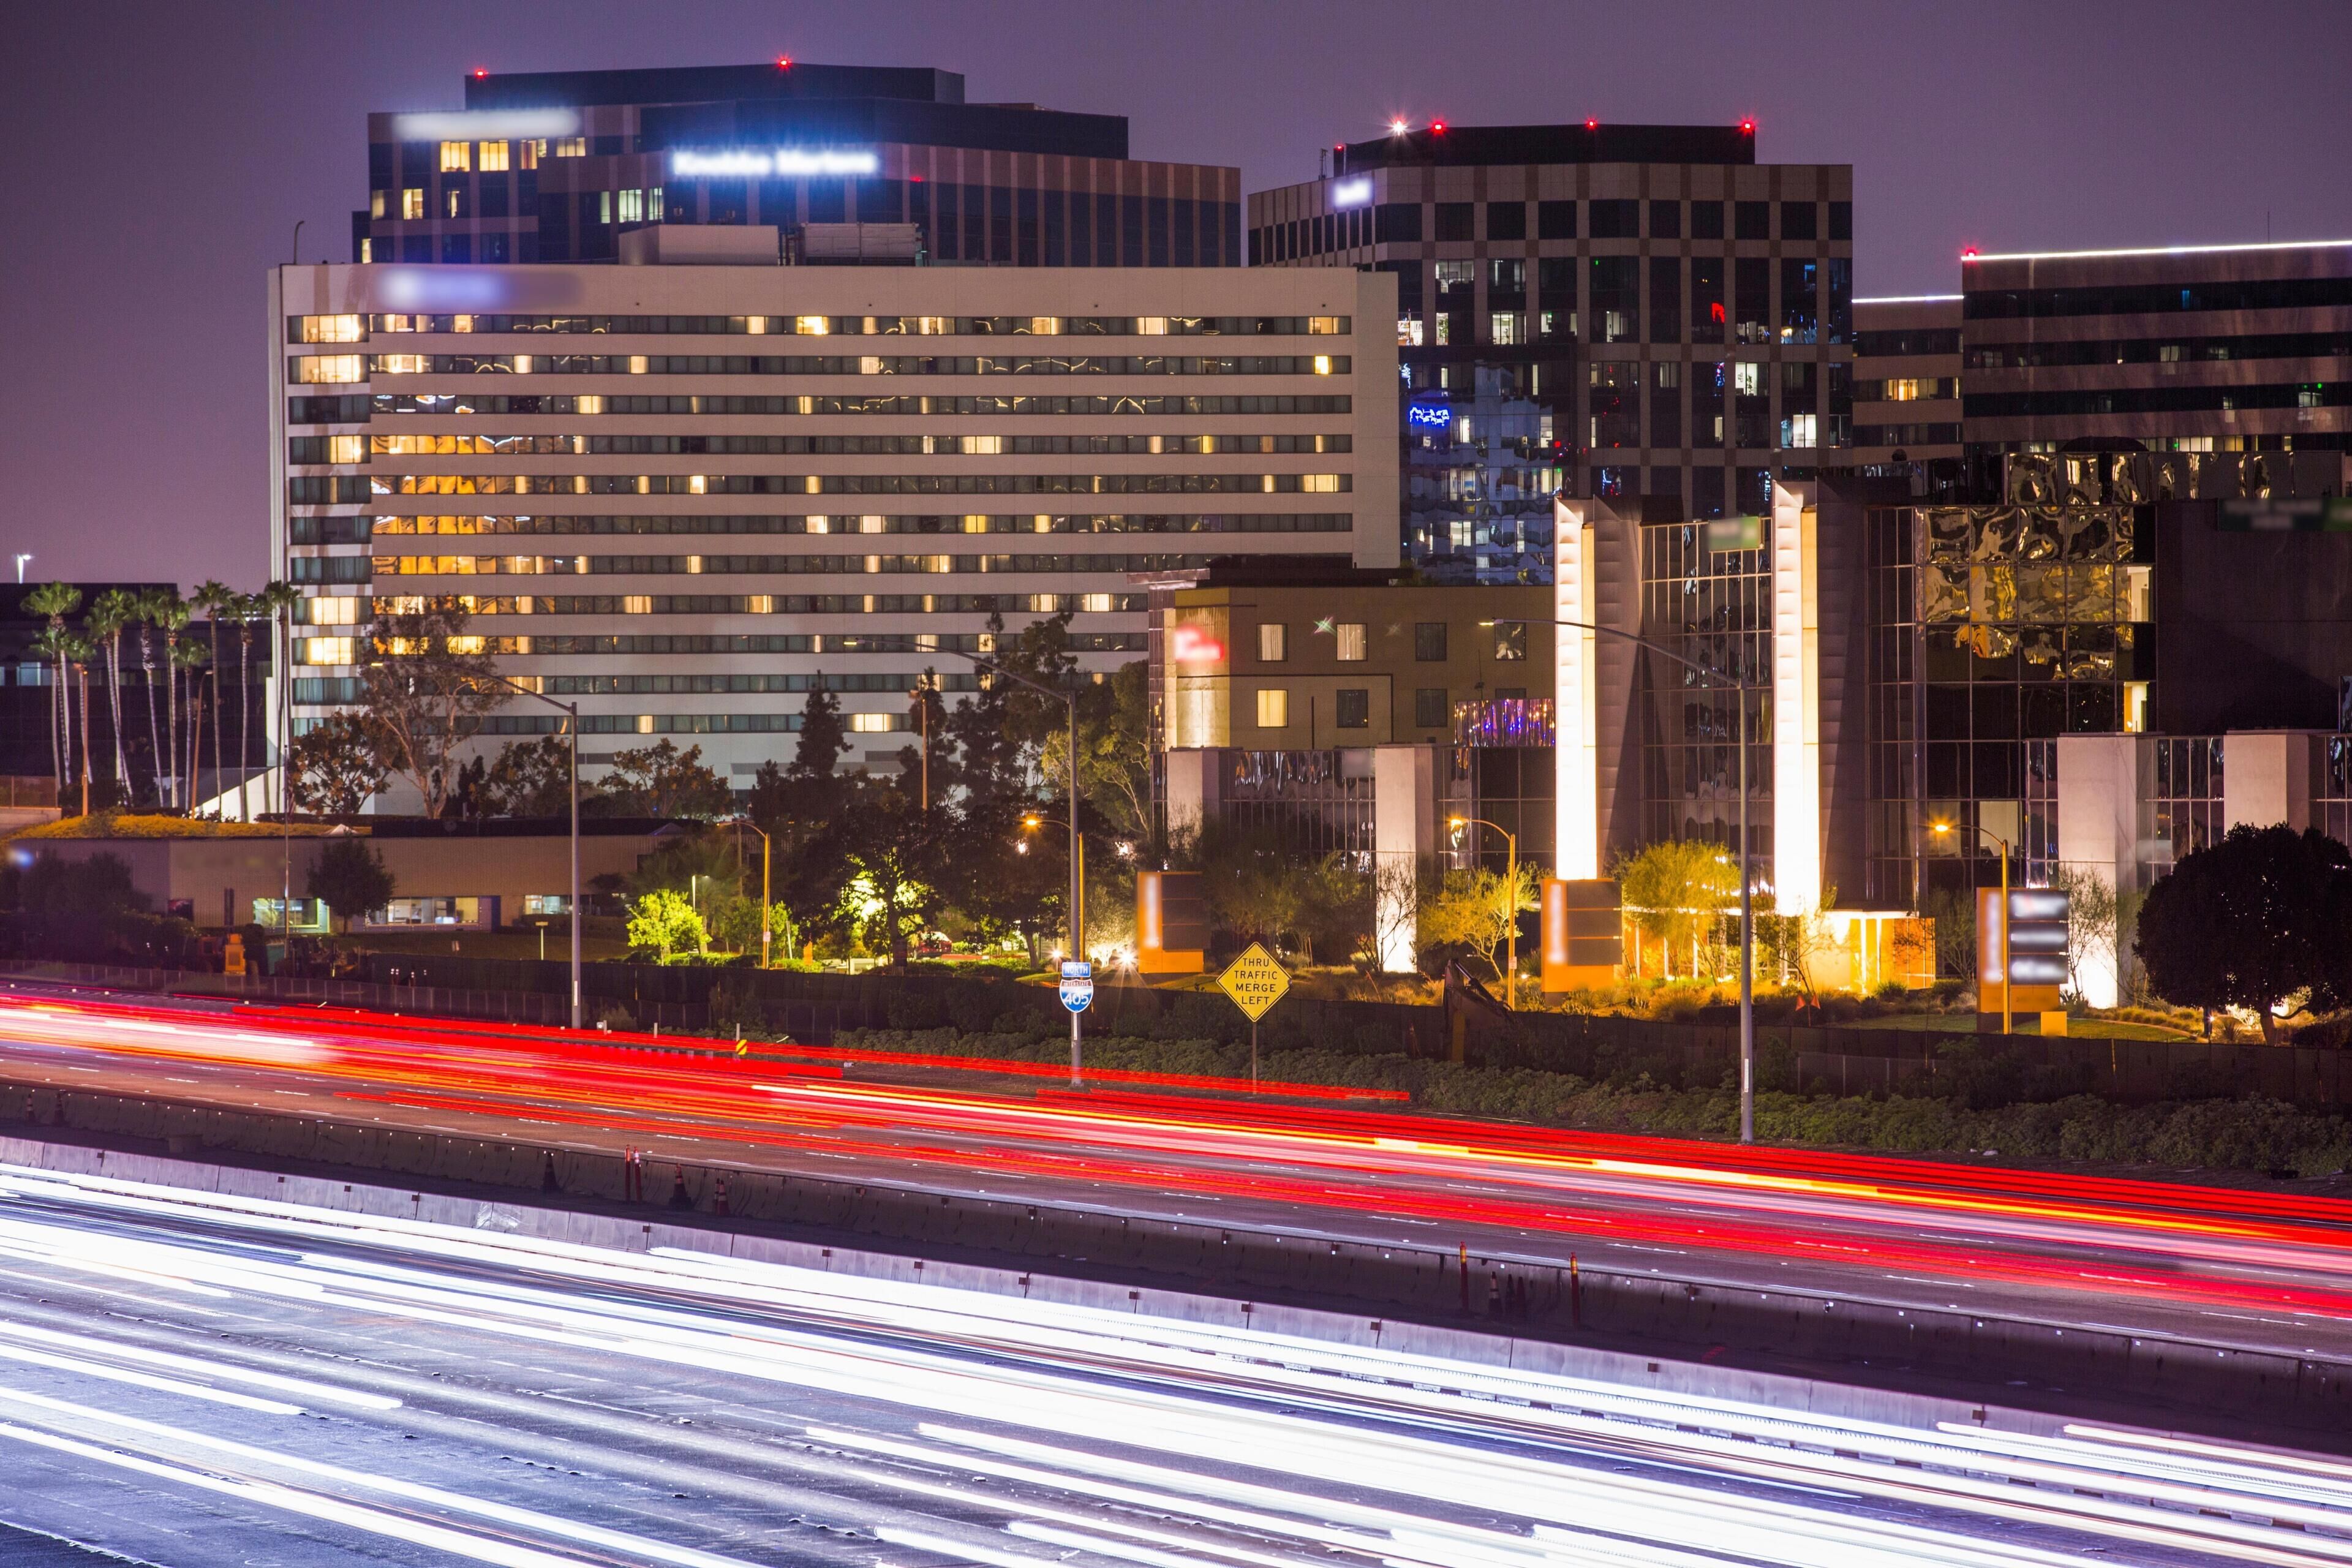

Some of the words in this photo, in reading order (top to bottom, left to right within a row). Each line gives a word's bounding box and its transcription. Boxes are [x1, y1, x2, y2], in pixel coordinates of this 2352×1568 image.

[1243, 958, 1269, 967] THRU
[1234, 970, 1278, 979] TRAFFIC
[1235, 984, 1276, 992] MERGE
[1063, 993, 1089, 1005] 405
